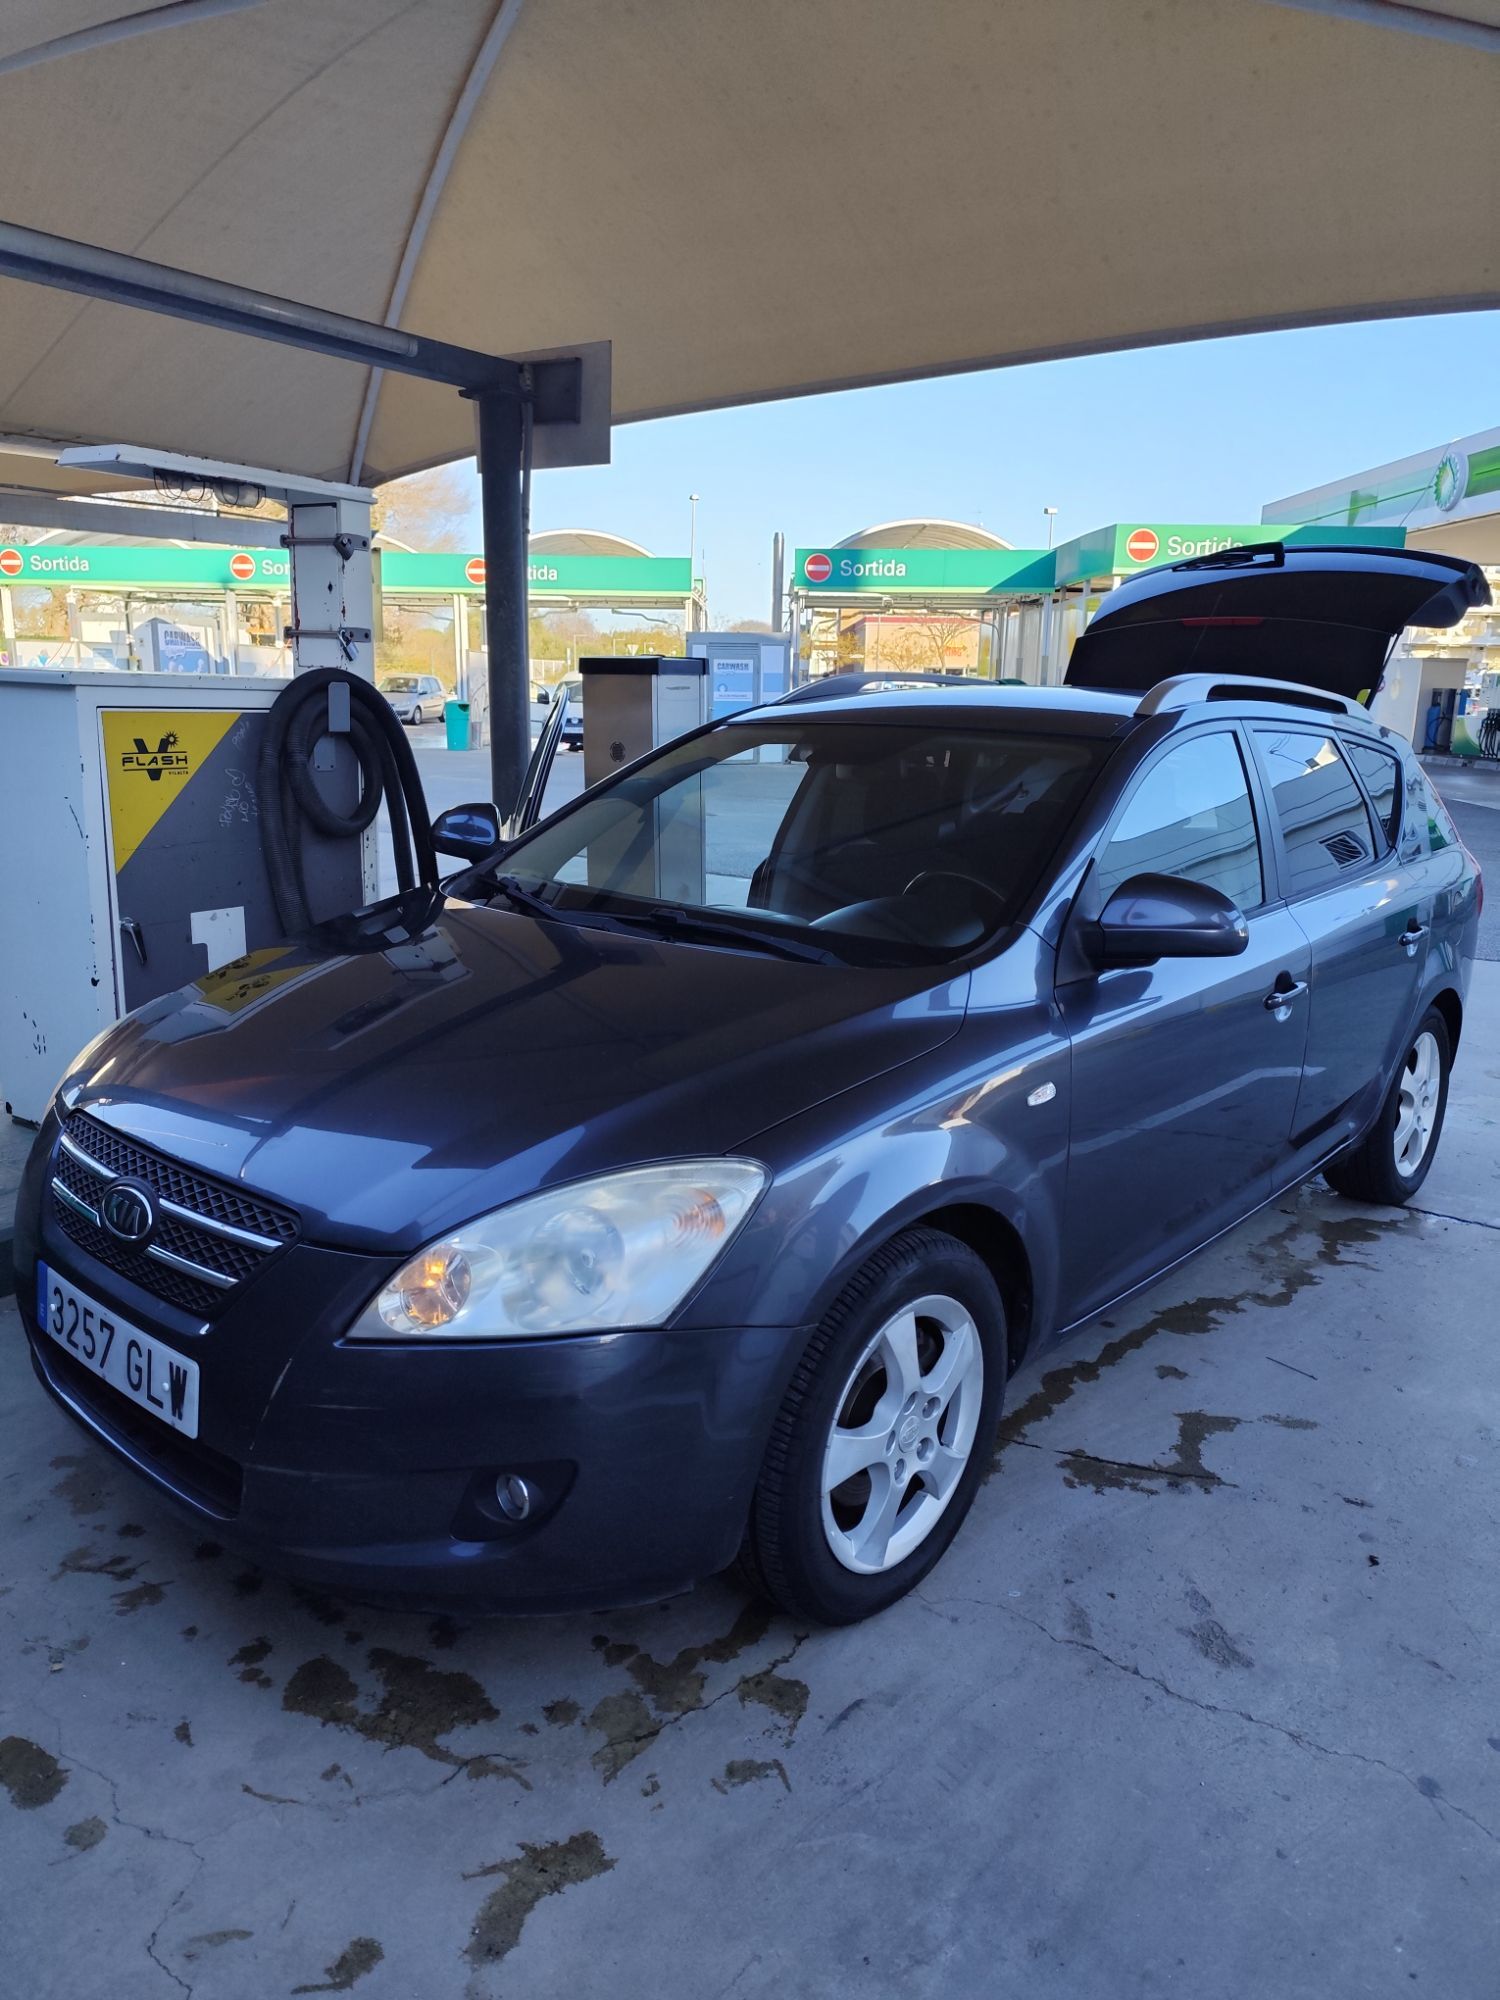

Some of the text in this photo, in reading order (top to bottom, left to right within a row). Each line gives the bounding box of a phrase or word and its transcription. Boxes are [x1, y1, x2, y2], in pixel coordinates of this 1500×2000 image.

[30, 555, 90, 572] Sortida
[840, 559, 907, 577] Sortida
[527, 564, 558, 581] tida
[717, 662, 750, 672] CARWASH
[122, 755, 188, 767] FLASH
[110, 1193, 141, 1235] KIA
[52, 1286, 188, 1422] 3257 GLW
